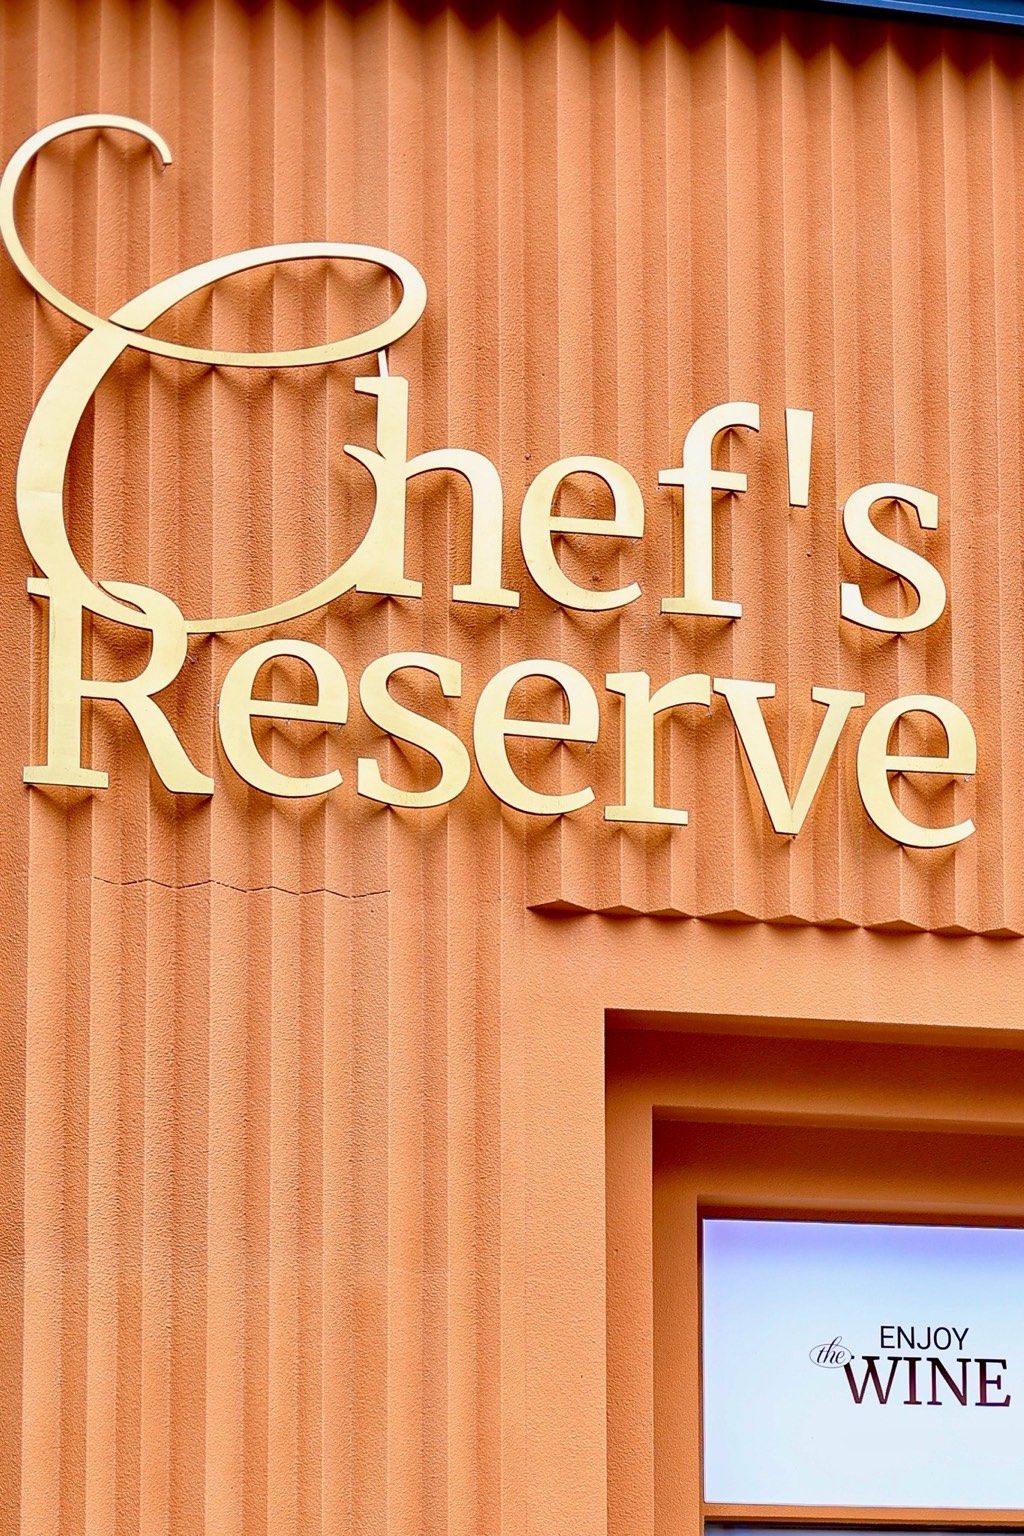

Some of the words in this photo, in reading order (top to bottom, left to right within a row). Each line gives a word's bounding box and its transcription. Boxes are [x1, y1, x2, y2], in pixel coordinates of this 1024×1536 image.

[0, 113, 946, 635] Chef's
[23, 576, 977, 849] Reserve
[816, 1336, 846, 1364] the
[843, 1355, 1011, 1407] WINE
[881, 1326, 969, 1350] ENJOY
